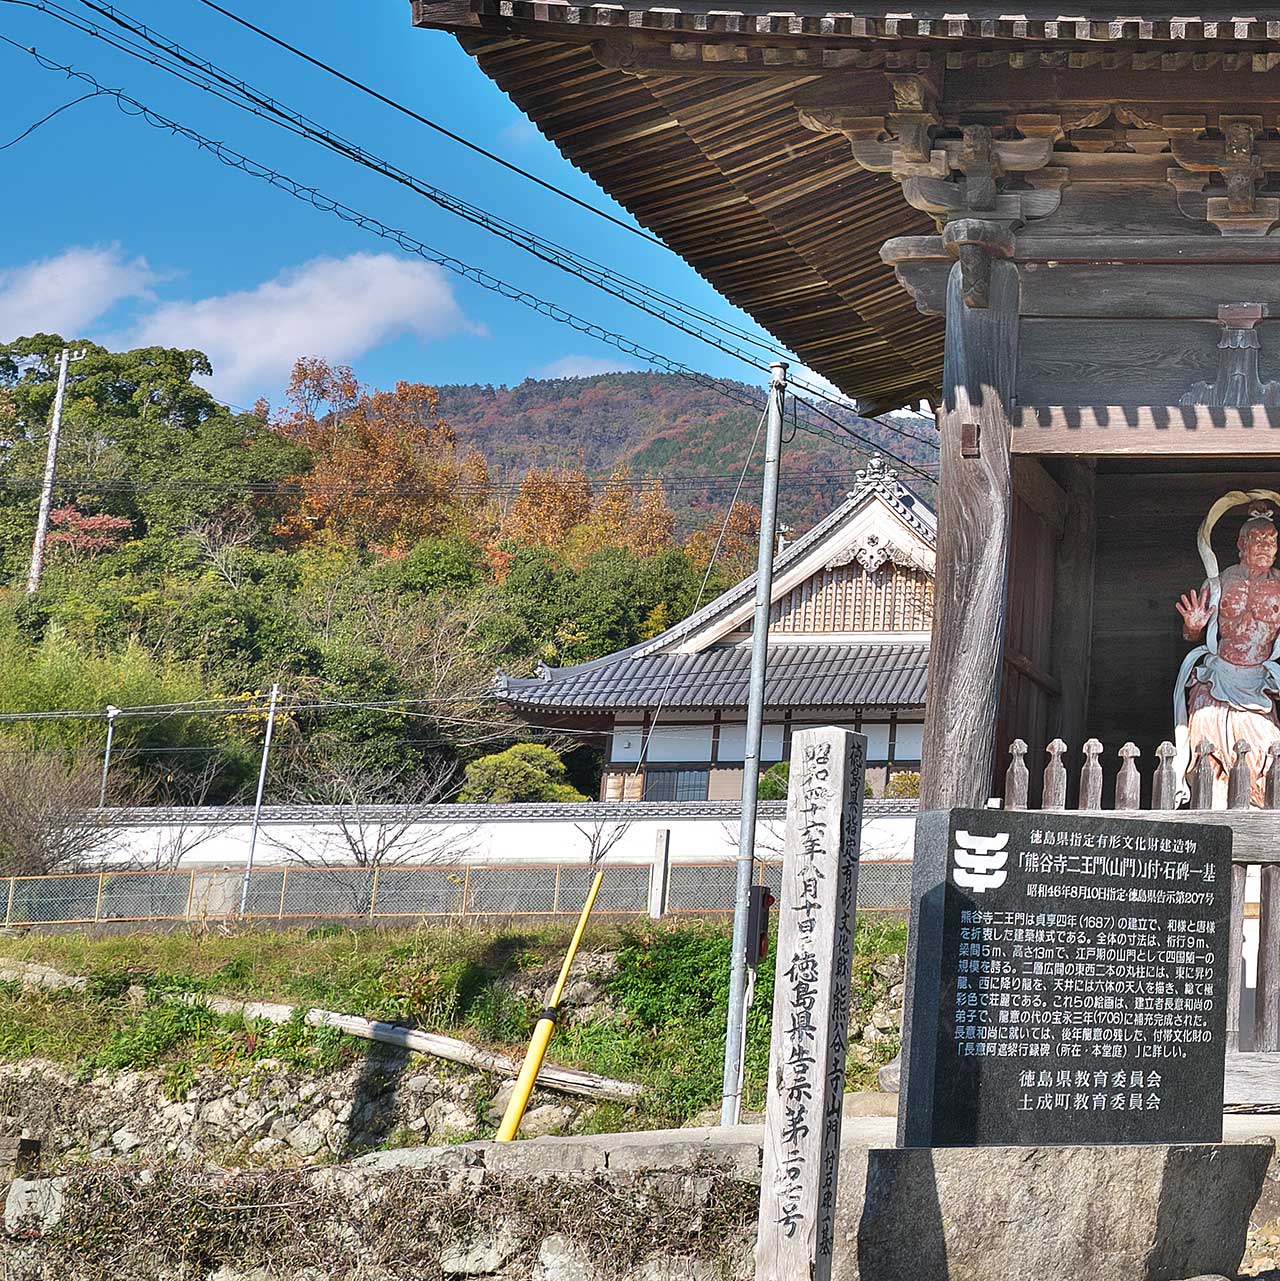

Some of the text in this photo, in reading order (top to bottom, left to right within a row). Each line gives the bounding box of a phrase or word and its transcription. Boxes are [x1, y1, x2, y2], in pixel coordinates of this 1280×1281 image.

[1030, 829, 1197, 854] 徳島県指定有形文化財建造物
[1018, 1070, 1162, 1089] 徳島県教育委員会
[1017, 1093, 1161, 1111] 土成町教育委員会
